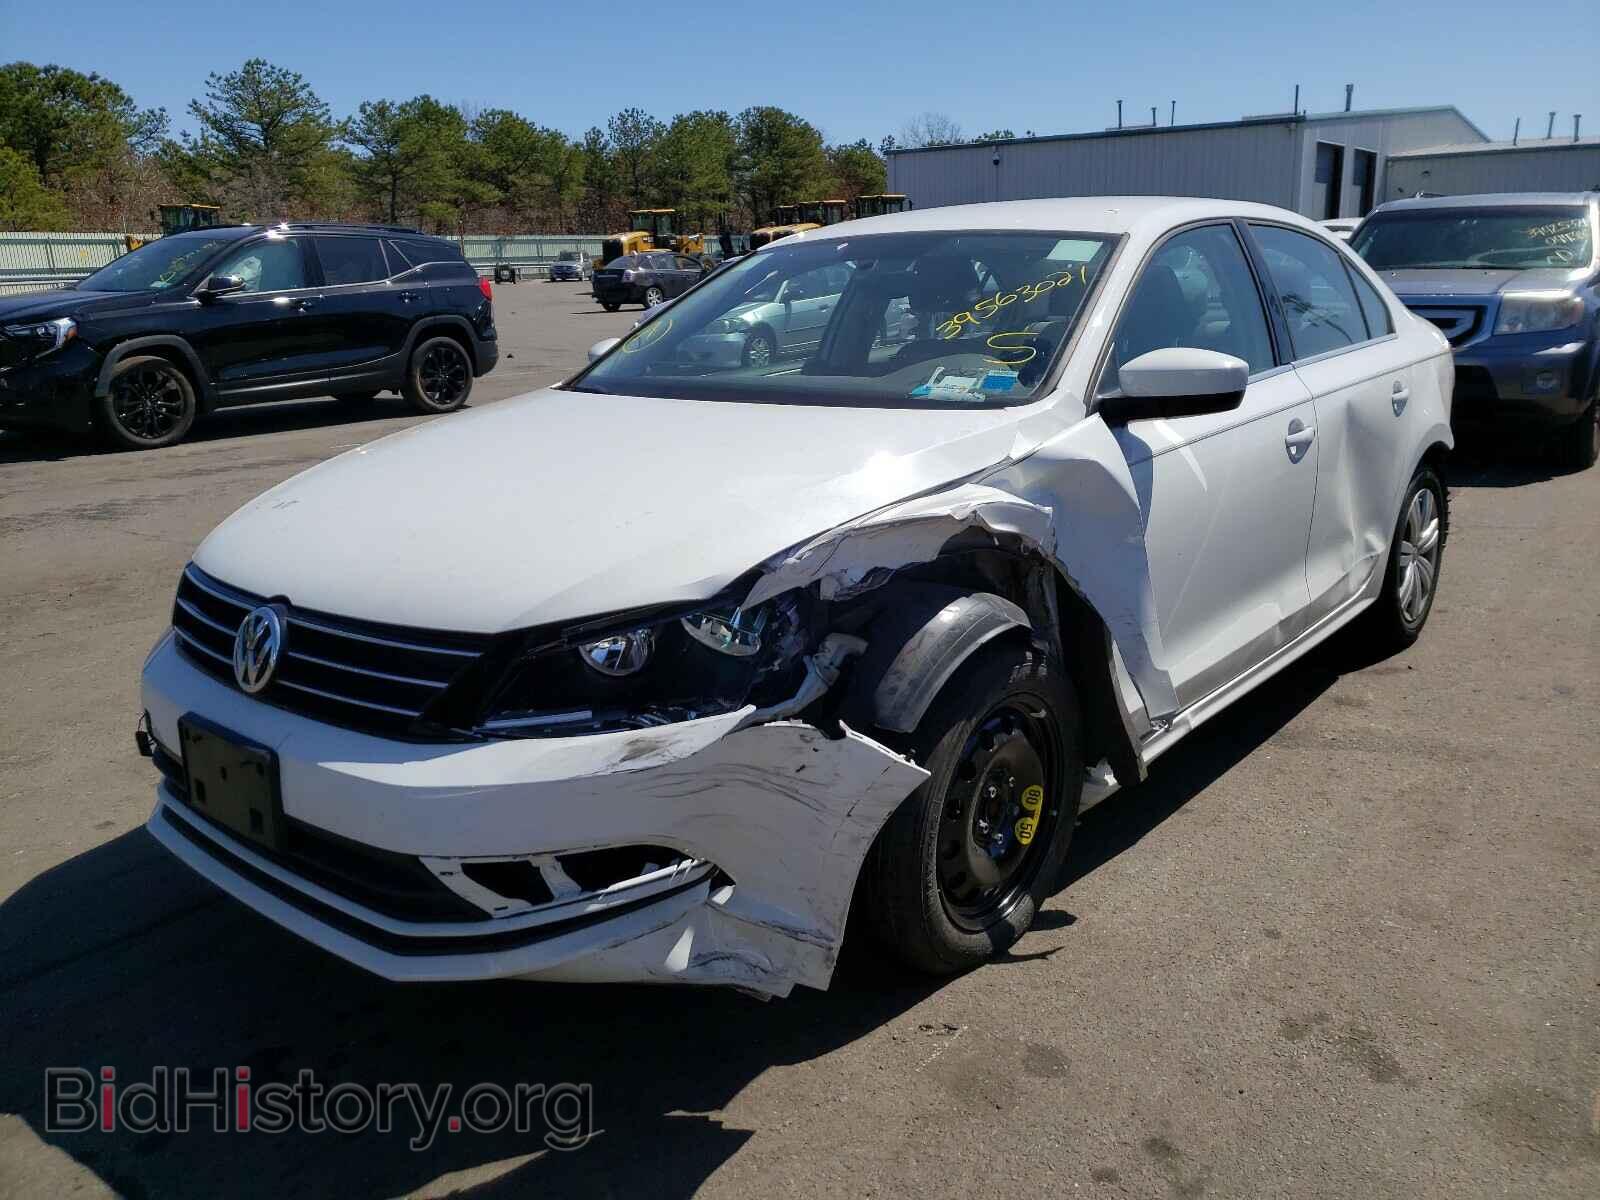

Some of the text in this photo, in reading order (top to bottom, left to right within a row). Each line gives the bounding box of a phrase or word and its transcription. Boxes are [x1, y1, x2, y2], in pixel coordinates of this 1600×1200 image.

[936, 265, 1086, 340] 39563021
[1025, 788, 1041, 805] 80
[1018, 822, 1033, 839] 50
